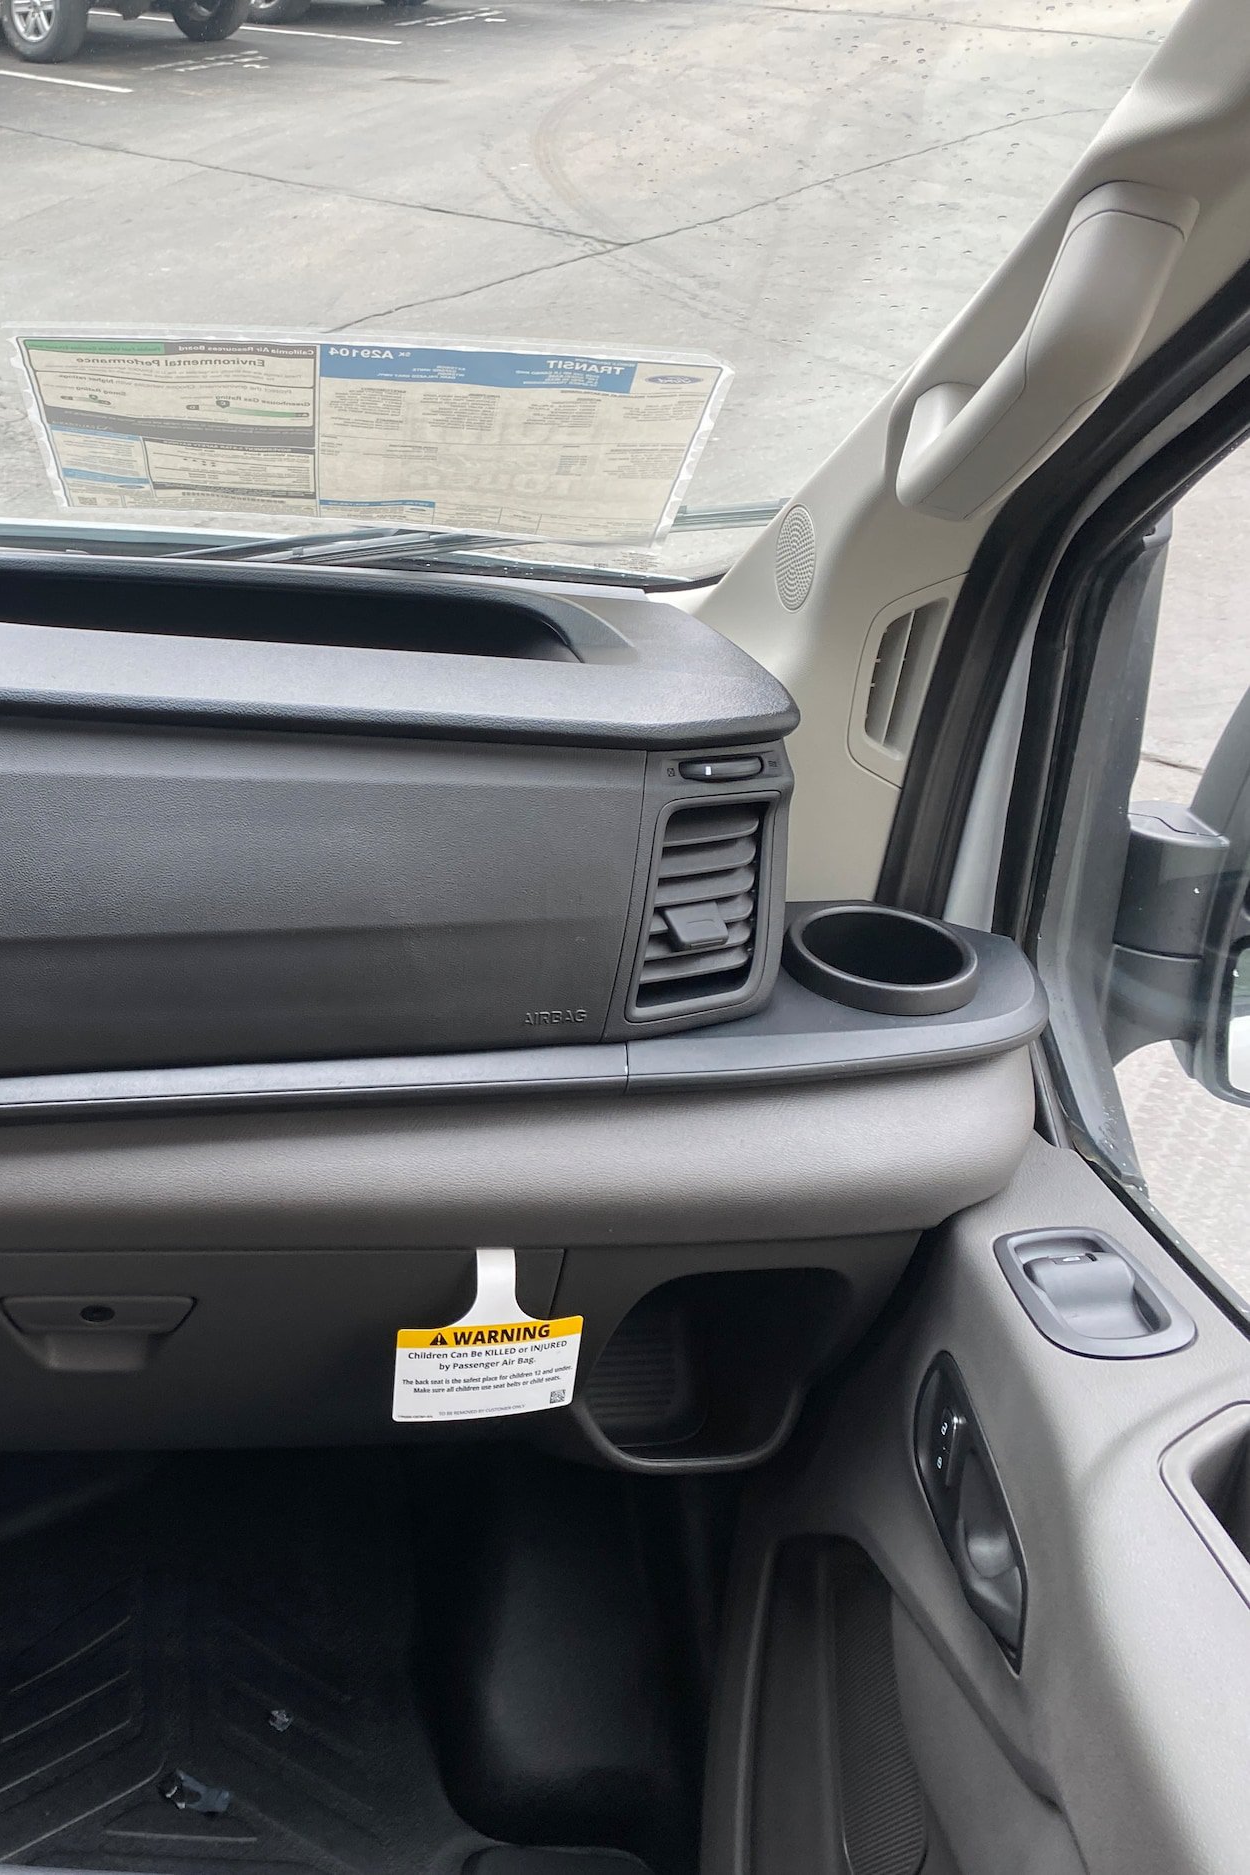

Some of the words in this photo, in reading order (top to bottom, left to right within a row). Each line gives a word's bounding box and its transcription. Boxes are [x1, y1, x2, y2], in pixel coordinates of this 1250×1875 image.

[524, 1009, 588, 1025] AIRBAG
[454, 1324, 550, 1345] WARNING
[408, 1351, 448, 1359] Children
[470, 1350, 483, 1358] Be
[485, 1347, 516, 1357] KILLED
[518, 1346, 528, 1354] or
[530, 1340, 567, 1352] INJURED
[439, 1363, 450, 1371] by
[453, 1360, 500, 1370] Passenger
[517, 1357, 536, 1365] Bag.
[482, 1375, 498, 1384] place
[554, 1365, 573, 1373] under.
